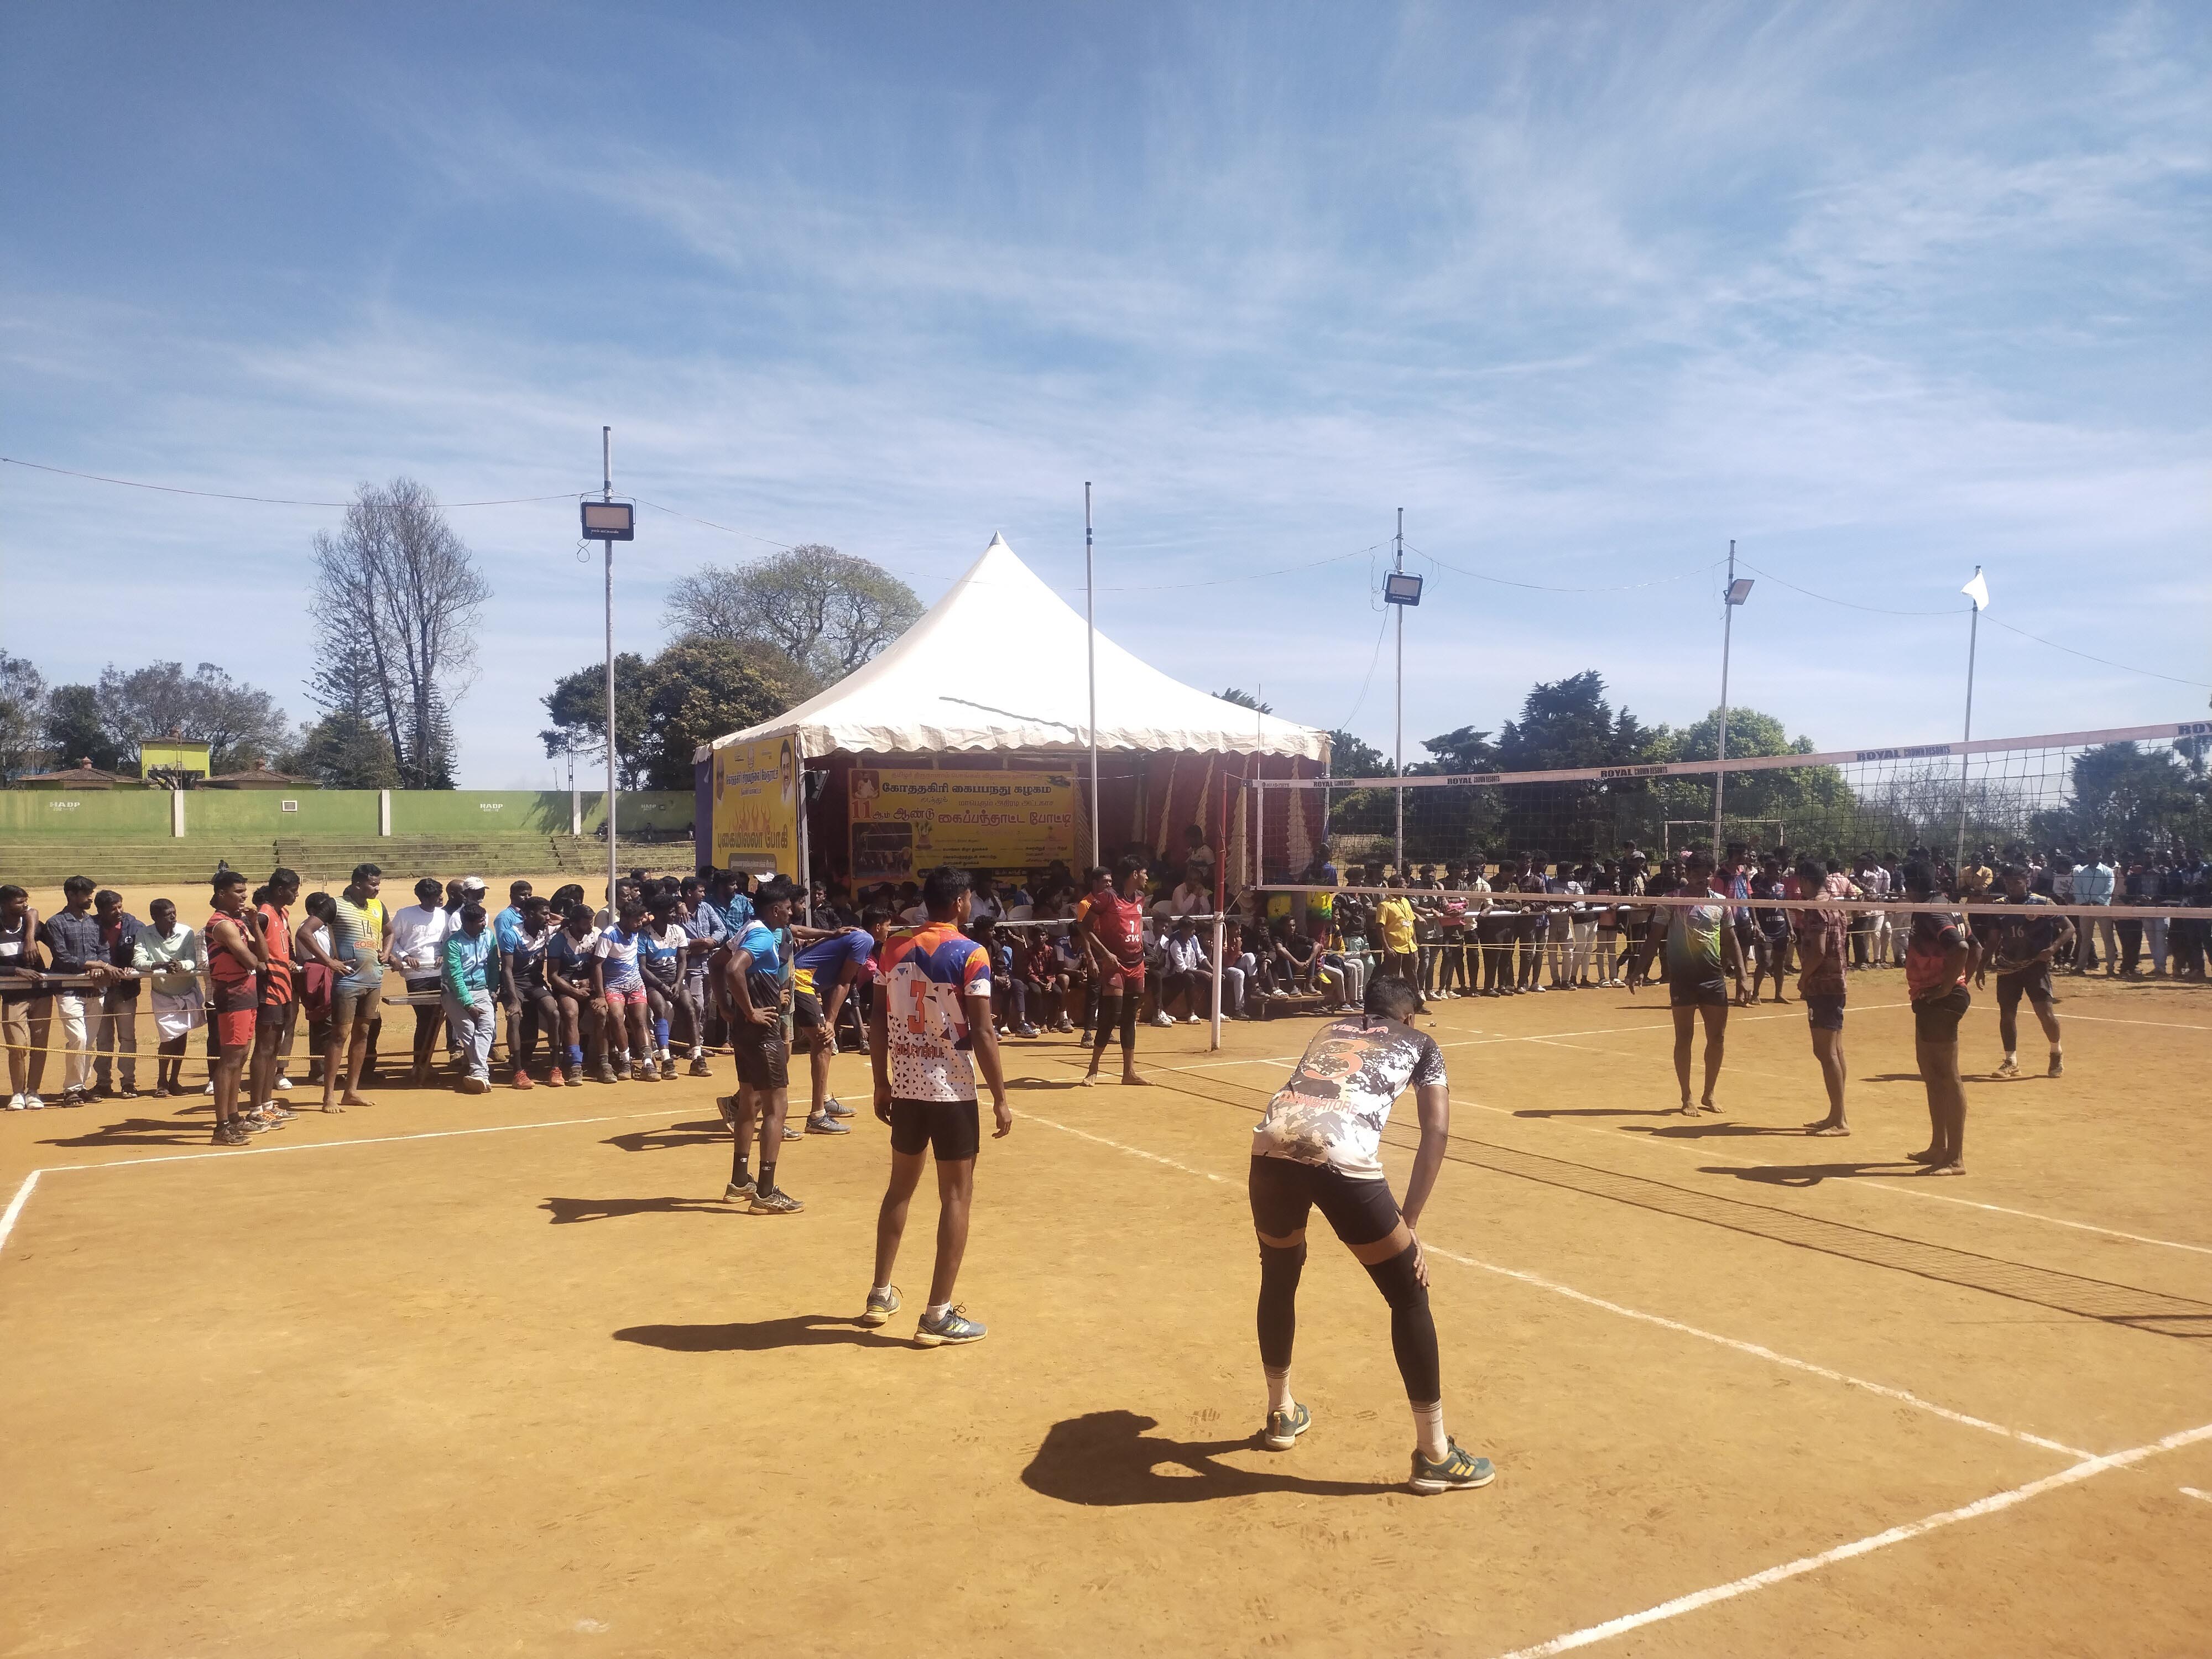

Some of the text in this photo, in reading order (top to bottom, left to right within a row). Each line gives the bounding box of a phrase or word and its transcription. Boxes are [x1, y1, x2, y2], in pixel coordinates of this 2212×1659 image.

[1856, 745, 1950, 761] ROYAL CROWN RESORTS
[1601, 769, 1632, 778] ROYAL
[852, 800, 871, 819] 11
[872, 811, 890, 820] ஆம்
[893, 807, 935, 821] ஆண்டு
[361, 920, 373, 938] 14
[2010, 925, 2025, 938] 16
[907, 979, 927, 1034] 3
[895, 1044, 945, 1058] OLLEYBALL
[1303, 1038, 1370, 1081] 3
